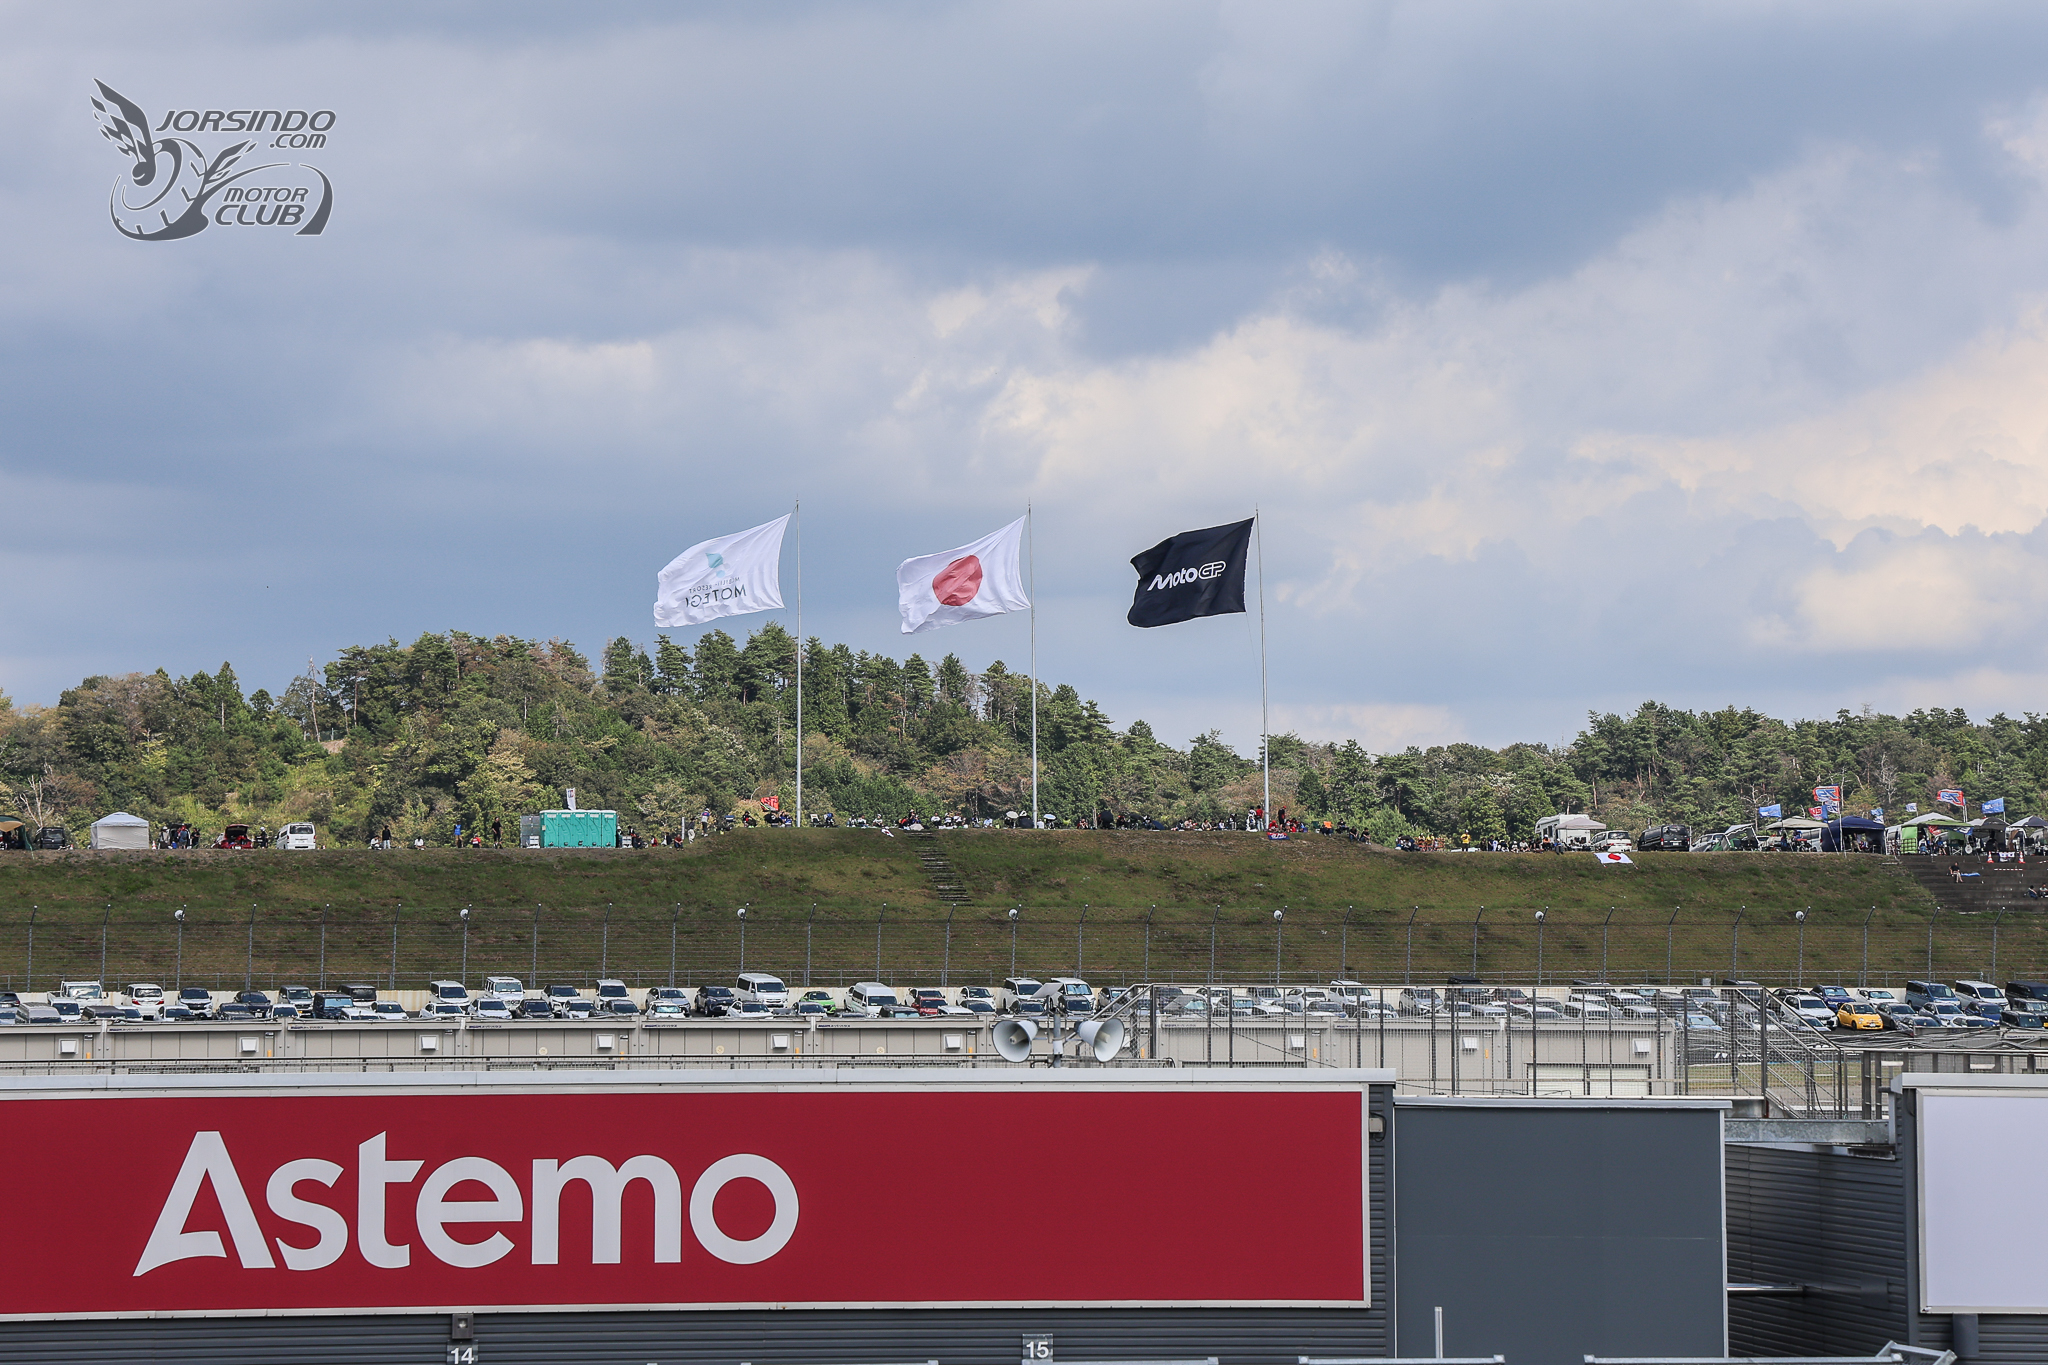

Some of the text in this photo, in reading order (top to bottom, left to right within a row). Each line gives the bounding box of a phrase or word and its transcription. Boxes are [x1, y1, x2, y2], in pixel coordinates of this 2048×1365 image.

[1147, 560, 1227, 591] MotoGP
[132, 1130, 800, 1277] Astemo
[450, 1347, 475, 1365] 14
[1026, 1341, 1049, 1359] 15
